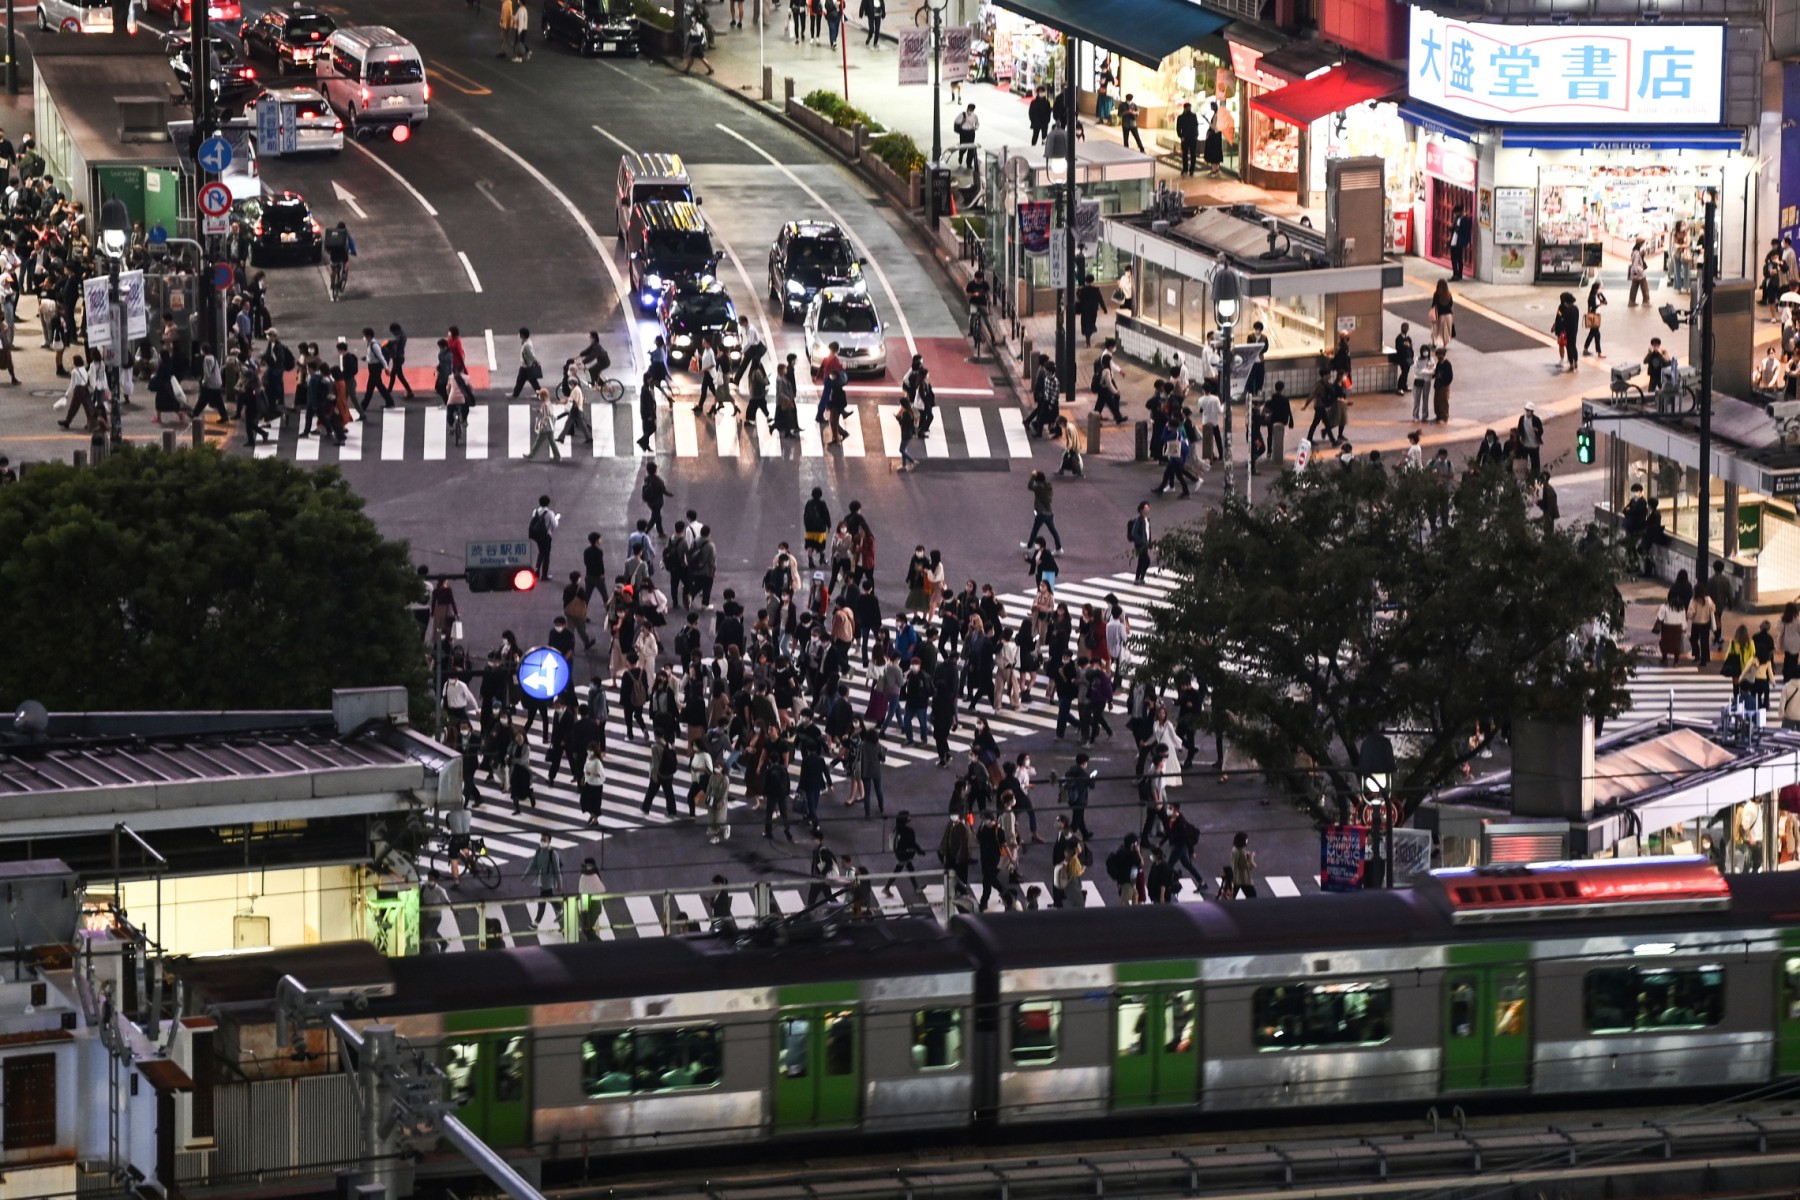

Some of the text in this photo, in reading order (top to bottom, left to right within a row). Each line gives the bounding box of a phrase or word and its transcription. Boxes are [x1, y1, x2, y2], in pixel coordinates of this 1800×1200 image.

[1420, 28, 1695, 99] 大盛堂書店
[1592, 142, 1652, 150] TAISEIDO
[471, 544, 526, 556] 渋谷駅前
[1327, 849, 1360, 860] MUSIC
[1327, 857, 1360, 868] FESTIVAL
